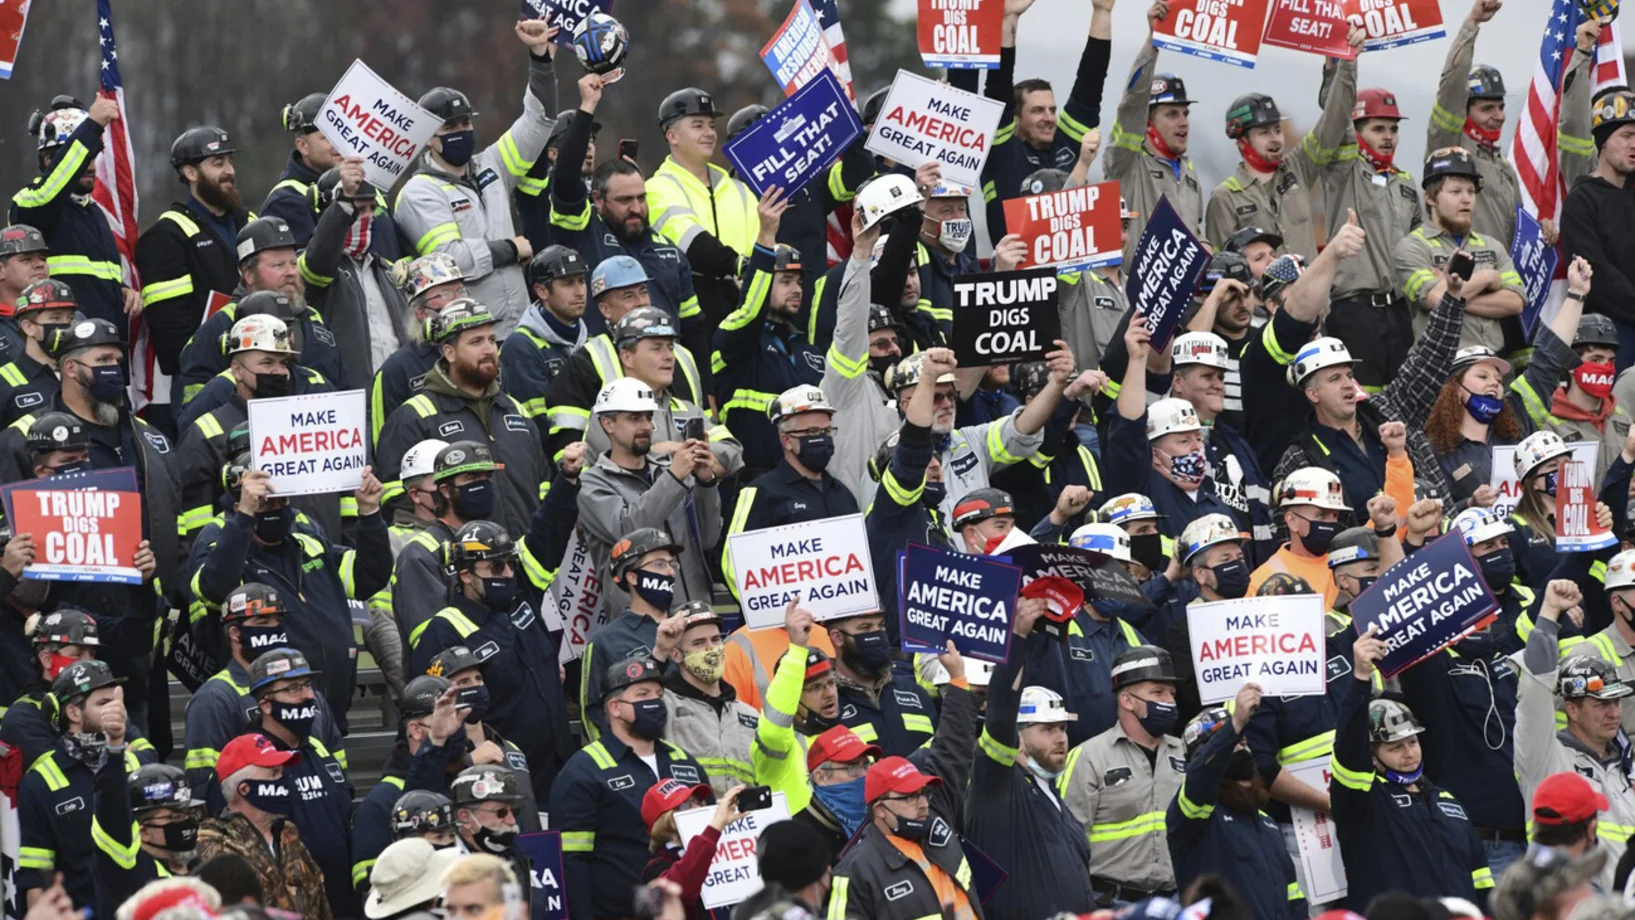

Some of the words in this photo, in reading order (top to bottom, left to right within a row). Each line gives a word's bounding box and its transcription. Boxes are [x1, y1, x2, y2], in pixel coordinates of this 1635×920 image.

[944, 10, 967, 24] DIGS
[1174, 8, 1238, 49] COAL
[1289, 19, 1332, 39] SEAT!
[1347, 4, 1418, 38] COAL
[934, 24, 980, 54] COAL
[373, 98, 414, 132] MAKE
[927, 97, 972, 122] MAKE
[325, 108, 370, 154] GREAT
[367, 150, 404, 176] AGAIN
[334, 94, 418, 160] AMERICA
[752, 140, 796, 182] FILL
[794, 101, 839, 148] THAT
[886, 106, 986, 152] AMERICA
[784, 134, 833, 184] SEAT!
[880, 126, 932, 156] GREAT
[936, 148, 981, 171] AGAIN
[1026, 186, 1100, 222] TRUMP
[1050, 212, 1082, 234] DIGS
[1034, 226, 1098, 264] COAL
[1136, 234, 1160, 279] MAKE
[1528, 229, 1545, 272] THA
[1136, 227, 1188, 314] AMERICA
[1528, 260, 1548, 308] SEAT!
[954, 276, 1057, 307] TRUMP
[1143, 290, 1173, 336] GREAT
[1169, 242, 1199, 292] AGAIN
[989, 307, 1030, 328] DIGS
[975, 330, 1042, 355] COAL
[291, 410, 336, 428] MAKE
[259, 427, 362, 456] AMERICA
[261, 460, 318, 478] GREAT
[322, 454, 364, 472] AGAIN
[36, 490, 120, 518] TRUMP
[1563, 504, 1590, 535] COAL
[62, 517, 99, 534] DIGS
[45, 532, 118, 566] COAL
[770, 537, 822, 560] MAKE
[1040, 553, 1090, 565] MAKE
[744, 552, 864, 592] AMERICA
[935, 564, 983, 590] MAKE
[1022, 564, 1132, 588] AMERICA
[1382, 562, 1432, 602] MAKE
[748, 591, 801, 611] GREAT
[808, 578, 869, 602] AGAIN
[907, 580, 1008, 624] AMERICA
[1093, 581, 1141, 598] AGAIN
[1367, 562, 1474, 638] AMERICA
[1431, 582, 1484, 624] AGAIN
[906, 606, 950, 632] GREAT
[951, 621, 1007, 645] AGAIN
[1226, 613, 1280, 630] MAKE
[1199, 632, 1317, 663] AMERICA
[1202, 663, 1252, 684] GREAT
[1259, 660, 1318, 676] AGAIN
[705, 866, 750, 887] GREAT
